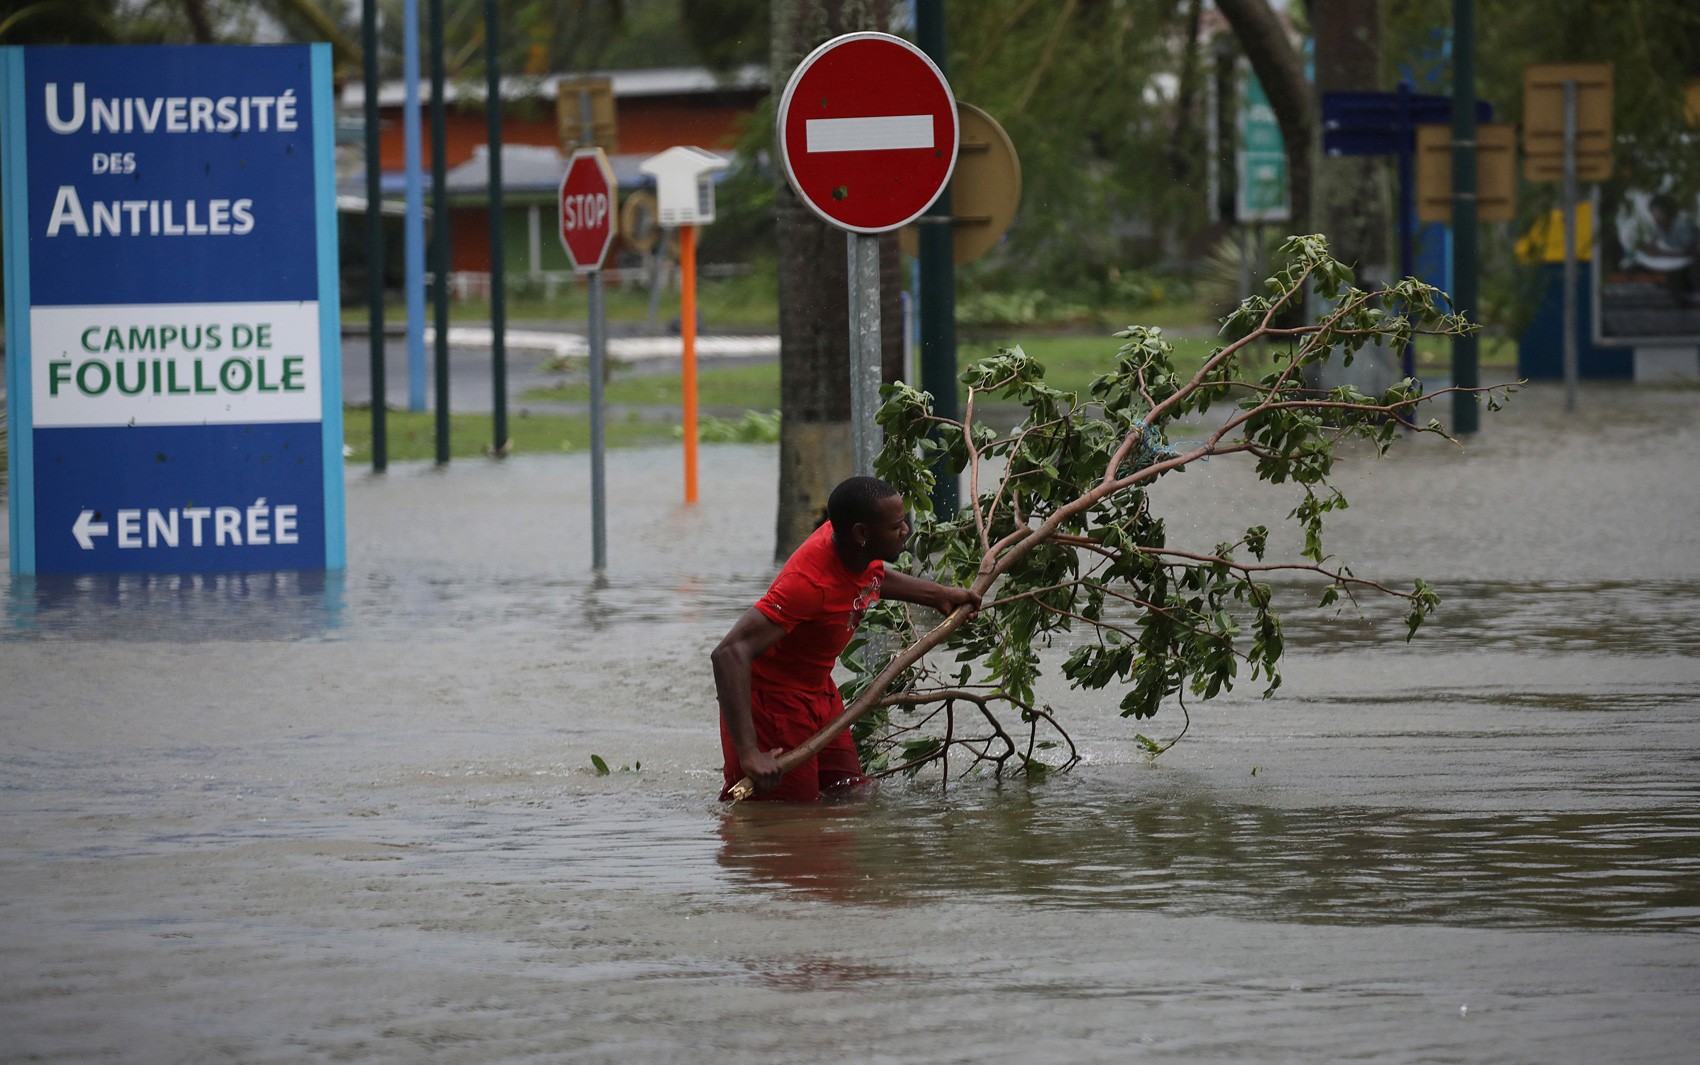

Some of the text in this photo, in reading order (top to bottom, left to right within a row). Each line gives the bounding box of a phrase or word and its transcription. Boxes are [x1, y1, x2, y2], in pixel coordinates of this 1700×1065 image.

[45, 82, 298, 134] UNIVERSITÉ
[92, 152, 136, 174] DES
[46, 185, 255, 237] ANTILLES
[564, 193, 609, 231] STOP
[81, 323, 272, 352] CAMPUS DE
[49, 356, 305, 397] FOUILLOLE
[117, 497, 299, 549] ENTRÉE
